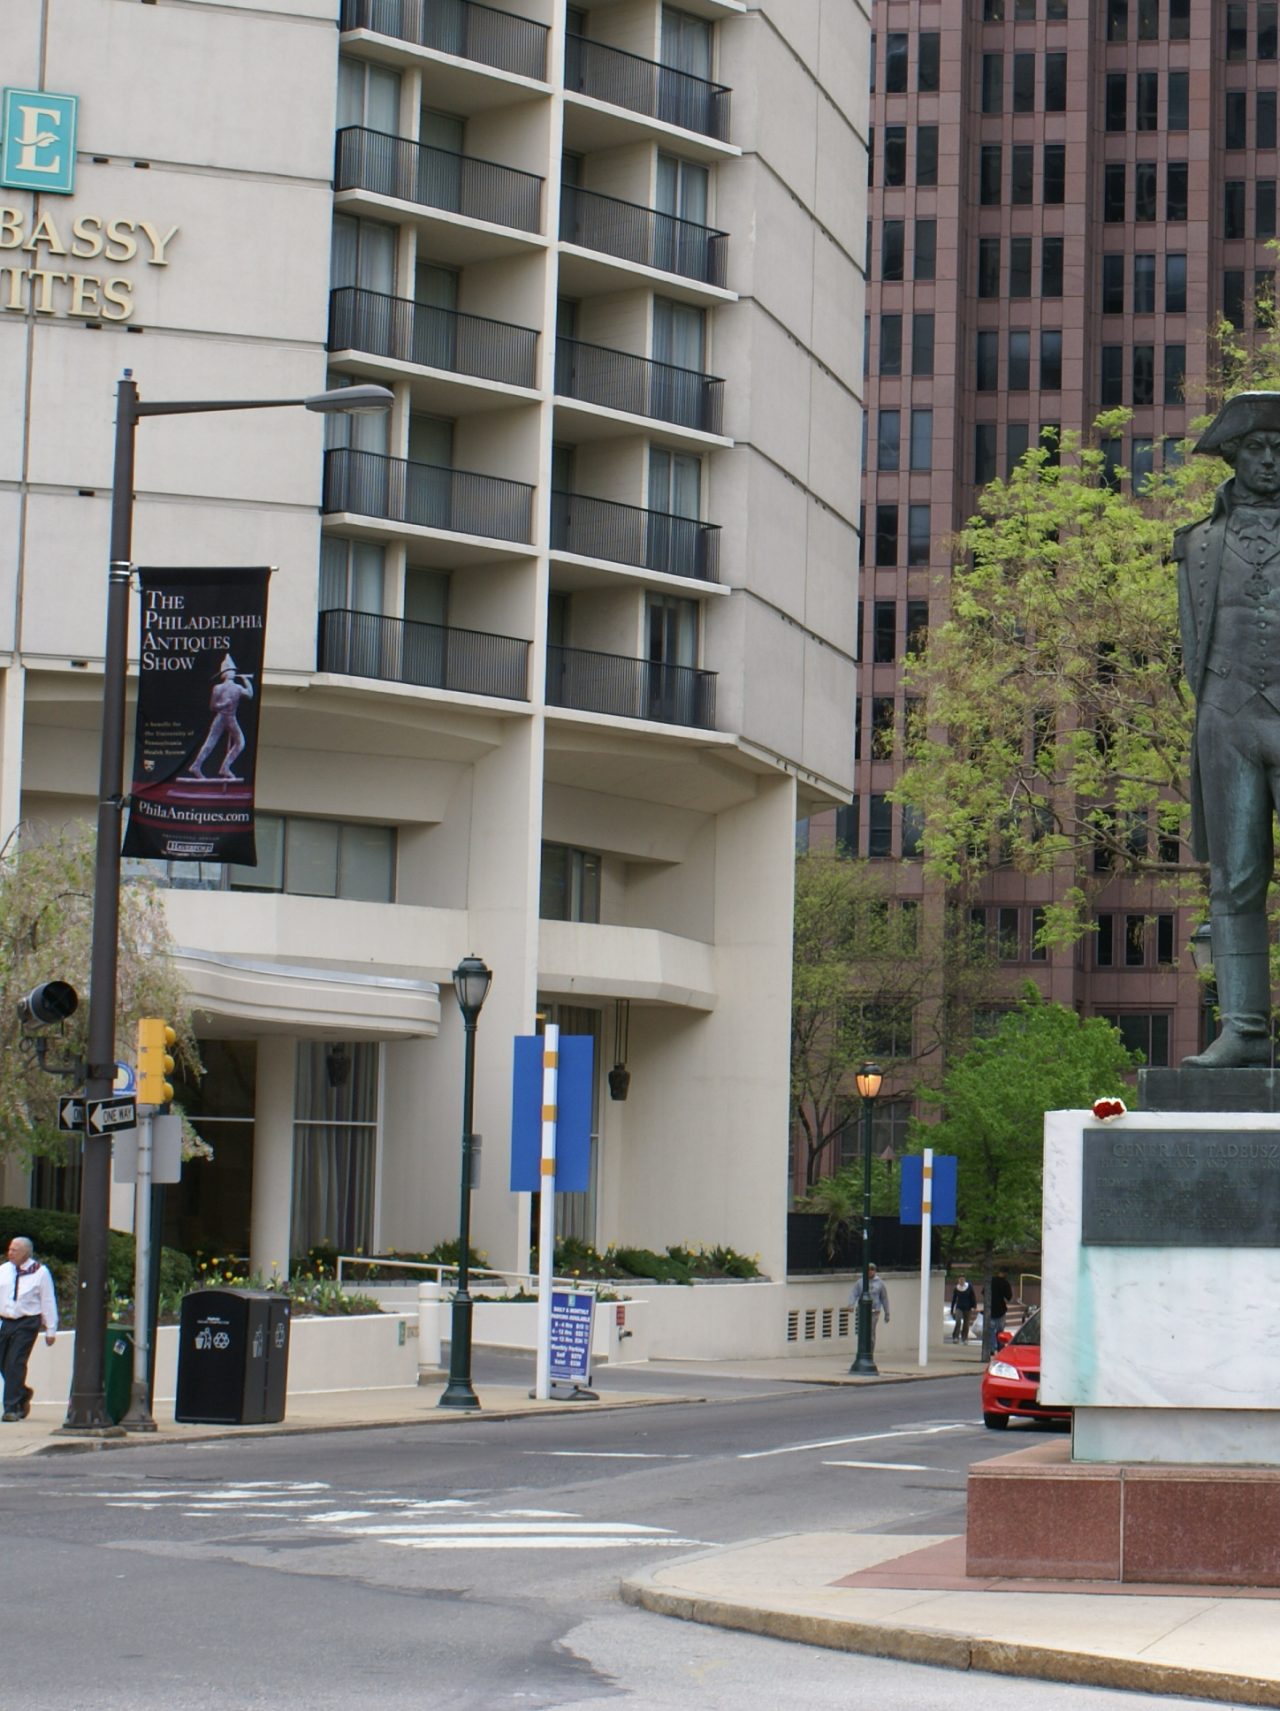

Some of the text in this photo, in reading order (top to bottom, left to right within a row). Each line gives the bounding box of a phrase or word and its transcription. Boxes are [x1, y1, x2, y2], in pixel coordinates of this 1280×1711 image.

[0, 267, 134, 321] ITES
[146, 590, 185, 610] THE
[145, 610, 263, 631] PHILADELPHIA
[143, 632, 231, 653] ANTIQUES
[143, 652, 195, 671] SHOW
[139, 800, 250, 824] PhilaAntiques.com
[103, 1106, 132, 1123] ONE WAY
